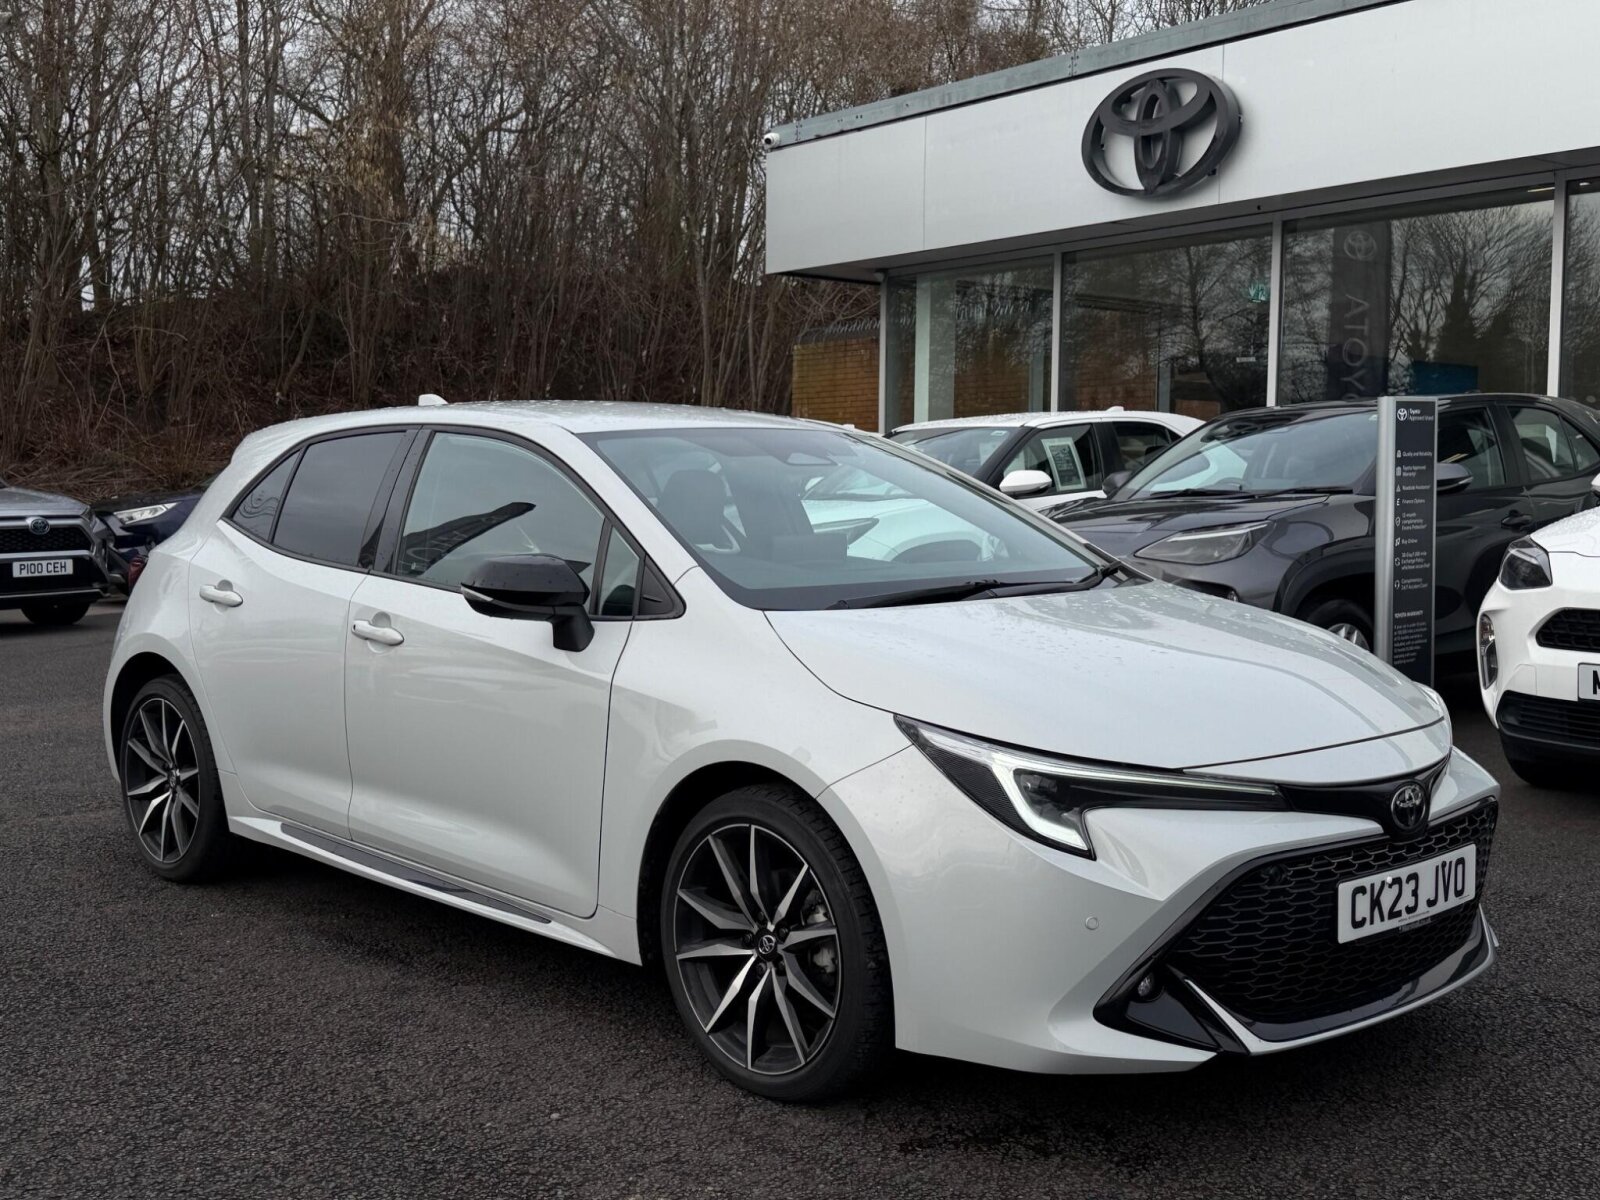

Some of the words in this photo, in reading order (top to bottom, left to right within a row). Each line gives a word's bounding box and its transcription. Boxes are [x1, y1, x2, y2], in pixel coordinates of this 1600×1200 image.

[19, 562, 43, 575] P100
[46, 561, 67, 574] CEH
[1350, 872, 1419, 930] CK23
[1426, 856, 1466, 908] JVO
